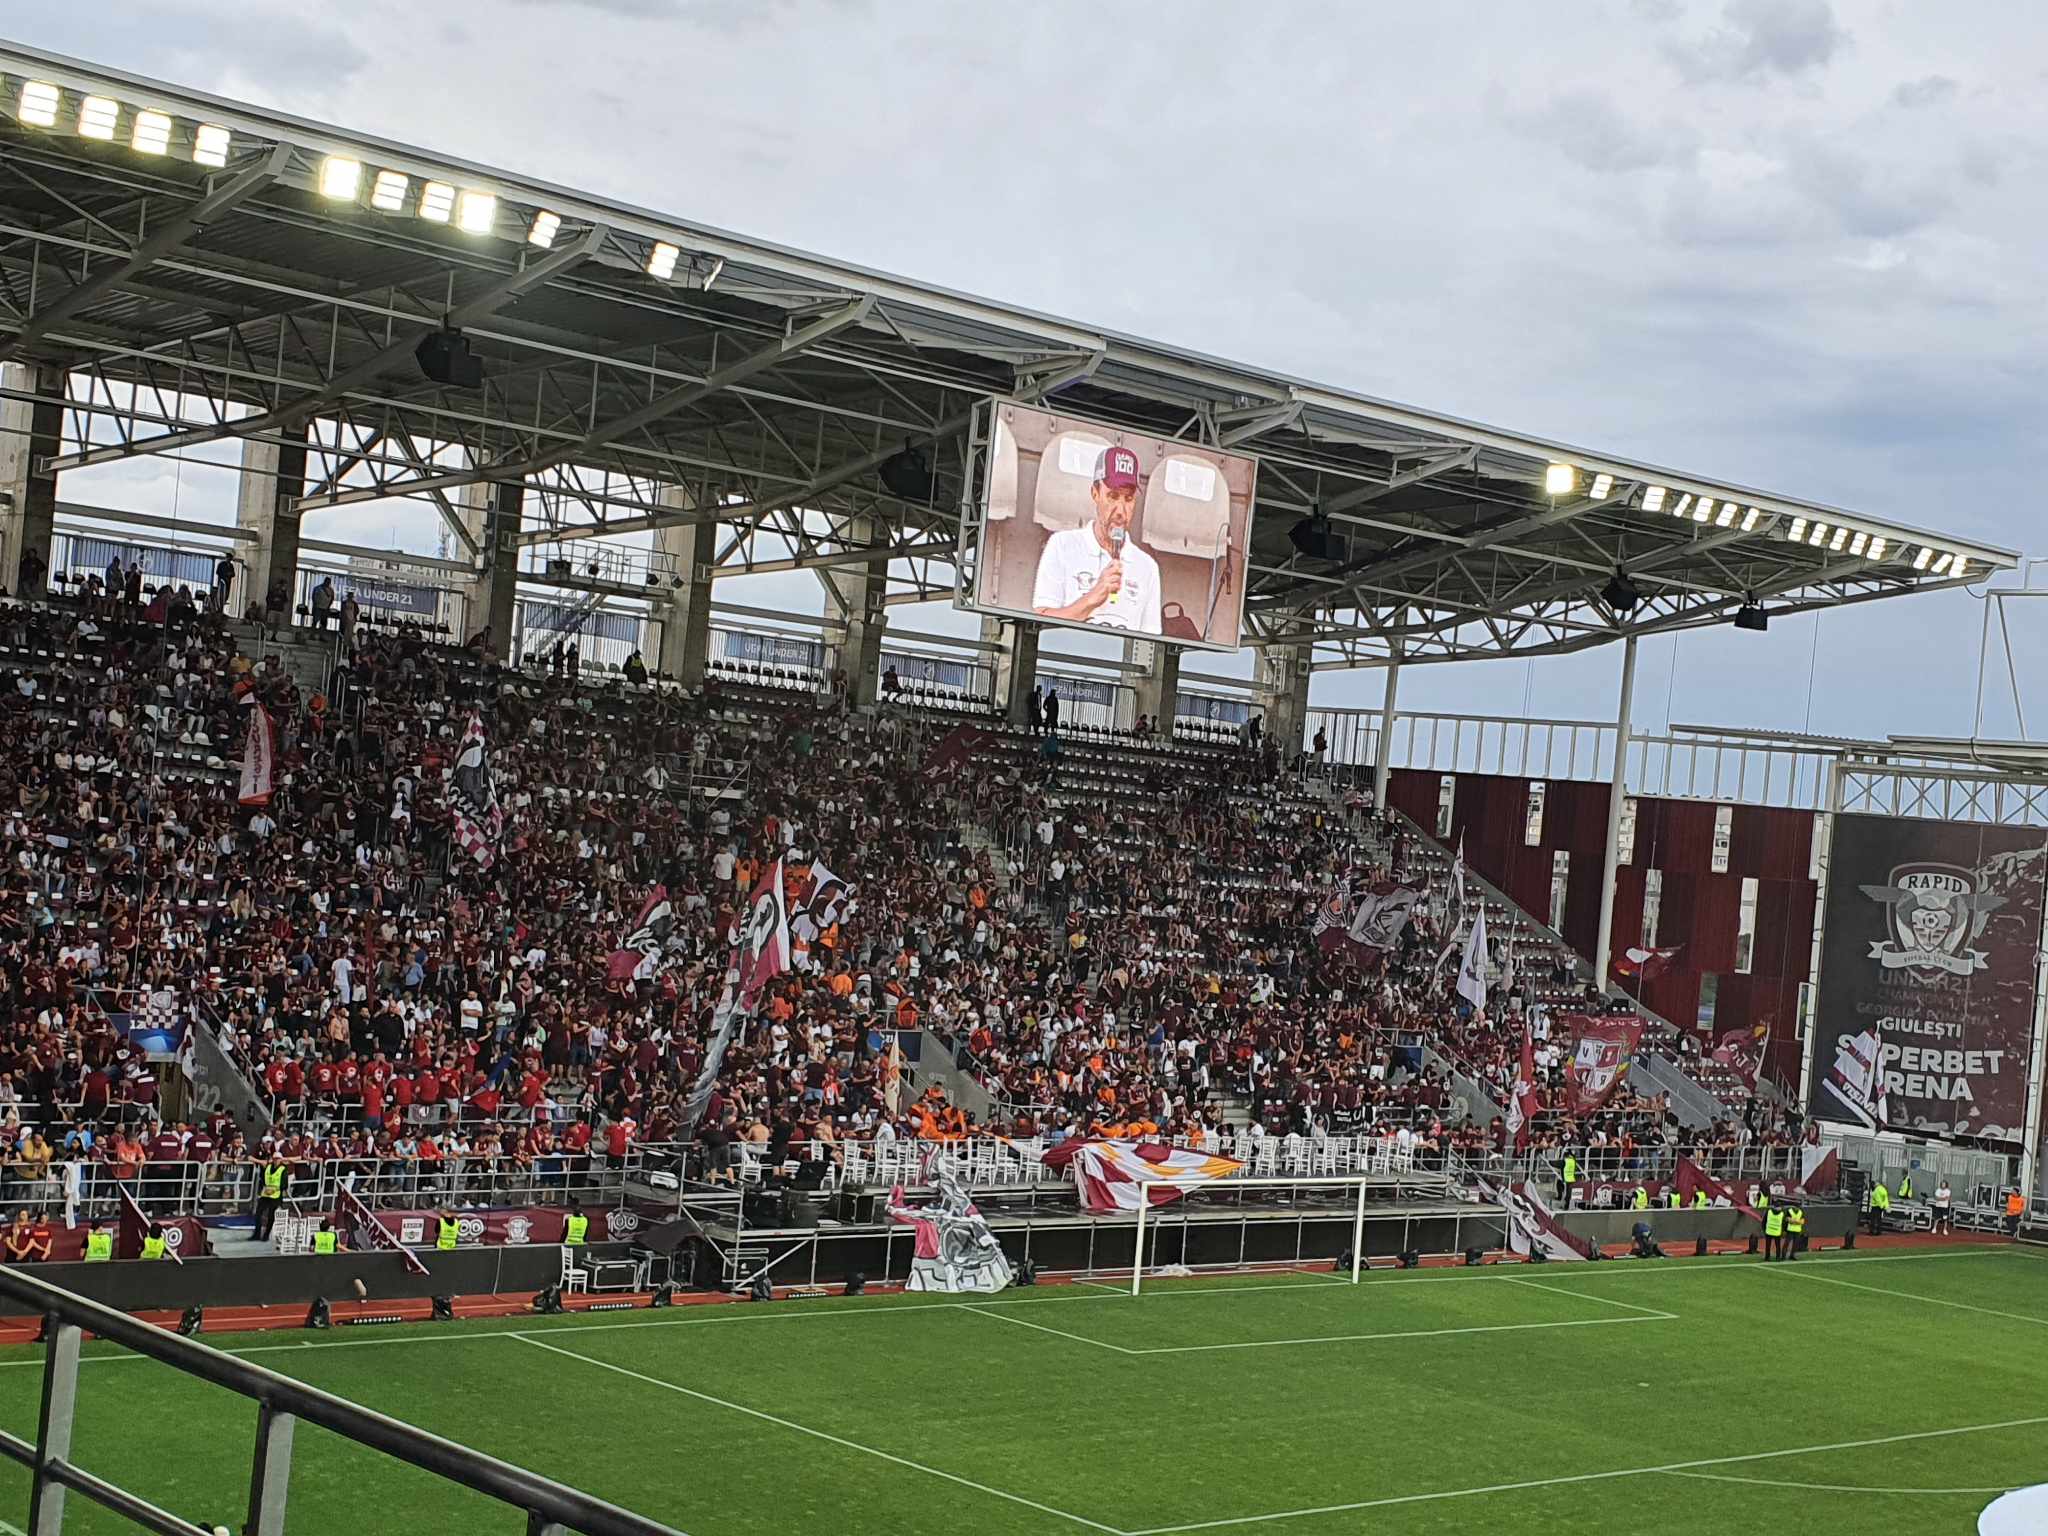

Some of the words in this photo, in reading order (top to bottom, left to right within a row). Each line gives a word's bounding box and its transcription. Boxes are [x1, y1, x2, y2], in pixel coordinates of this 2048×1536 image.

[1907, 875, 1963, 893] RAPID
[1881, 1016, 1962, 1040] GIULEȘTI
[1884, 1071, 1975, 1102] RENA
[457, 1218, 484, 1237] 00
[606, 1212, 639, 1233] 100
